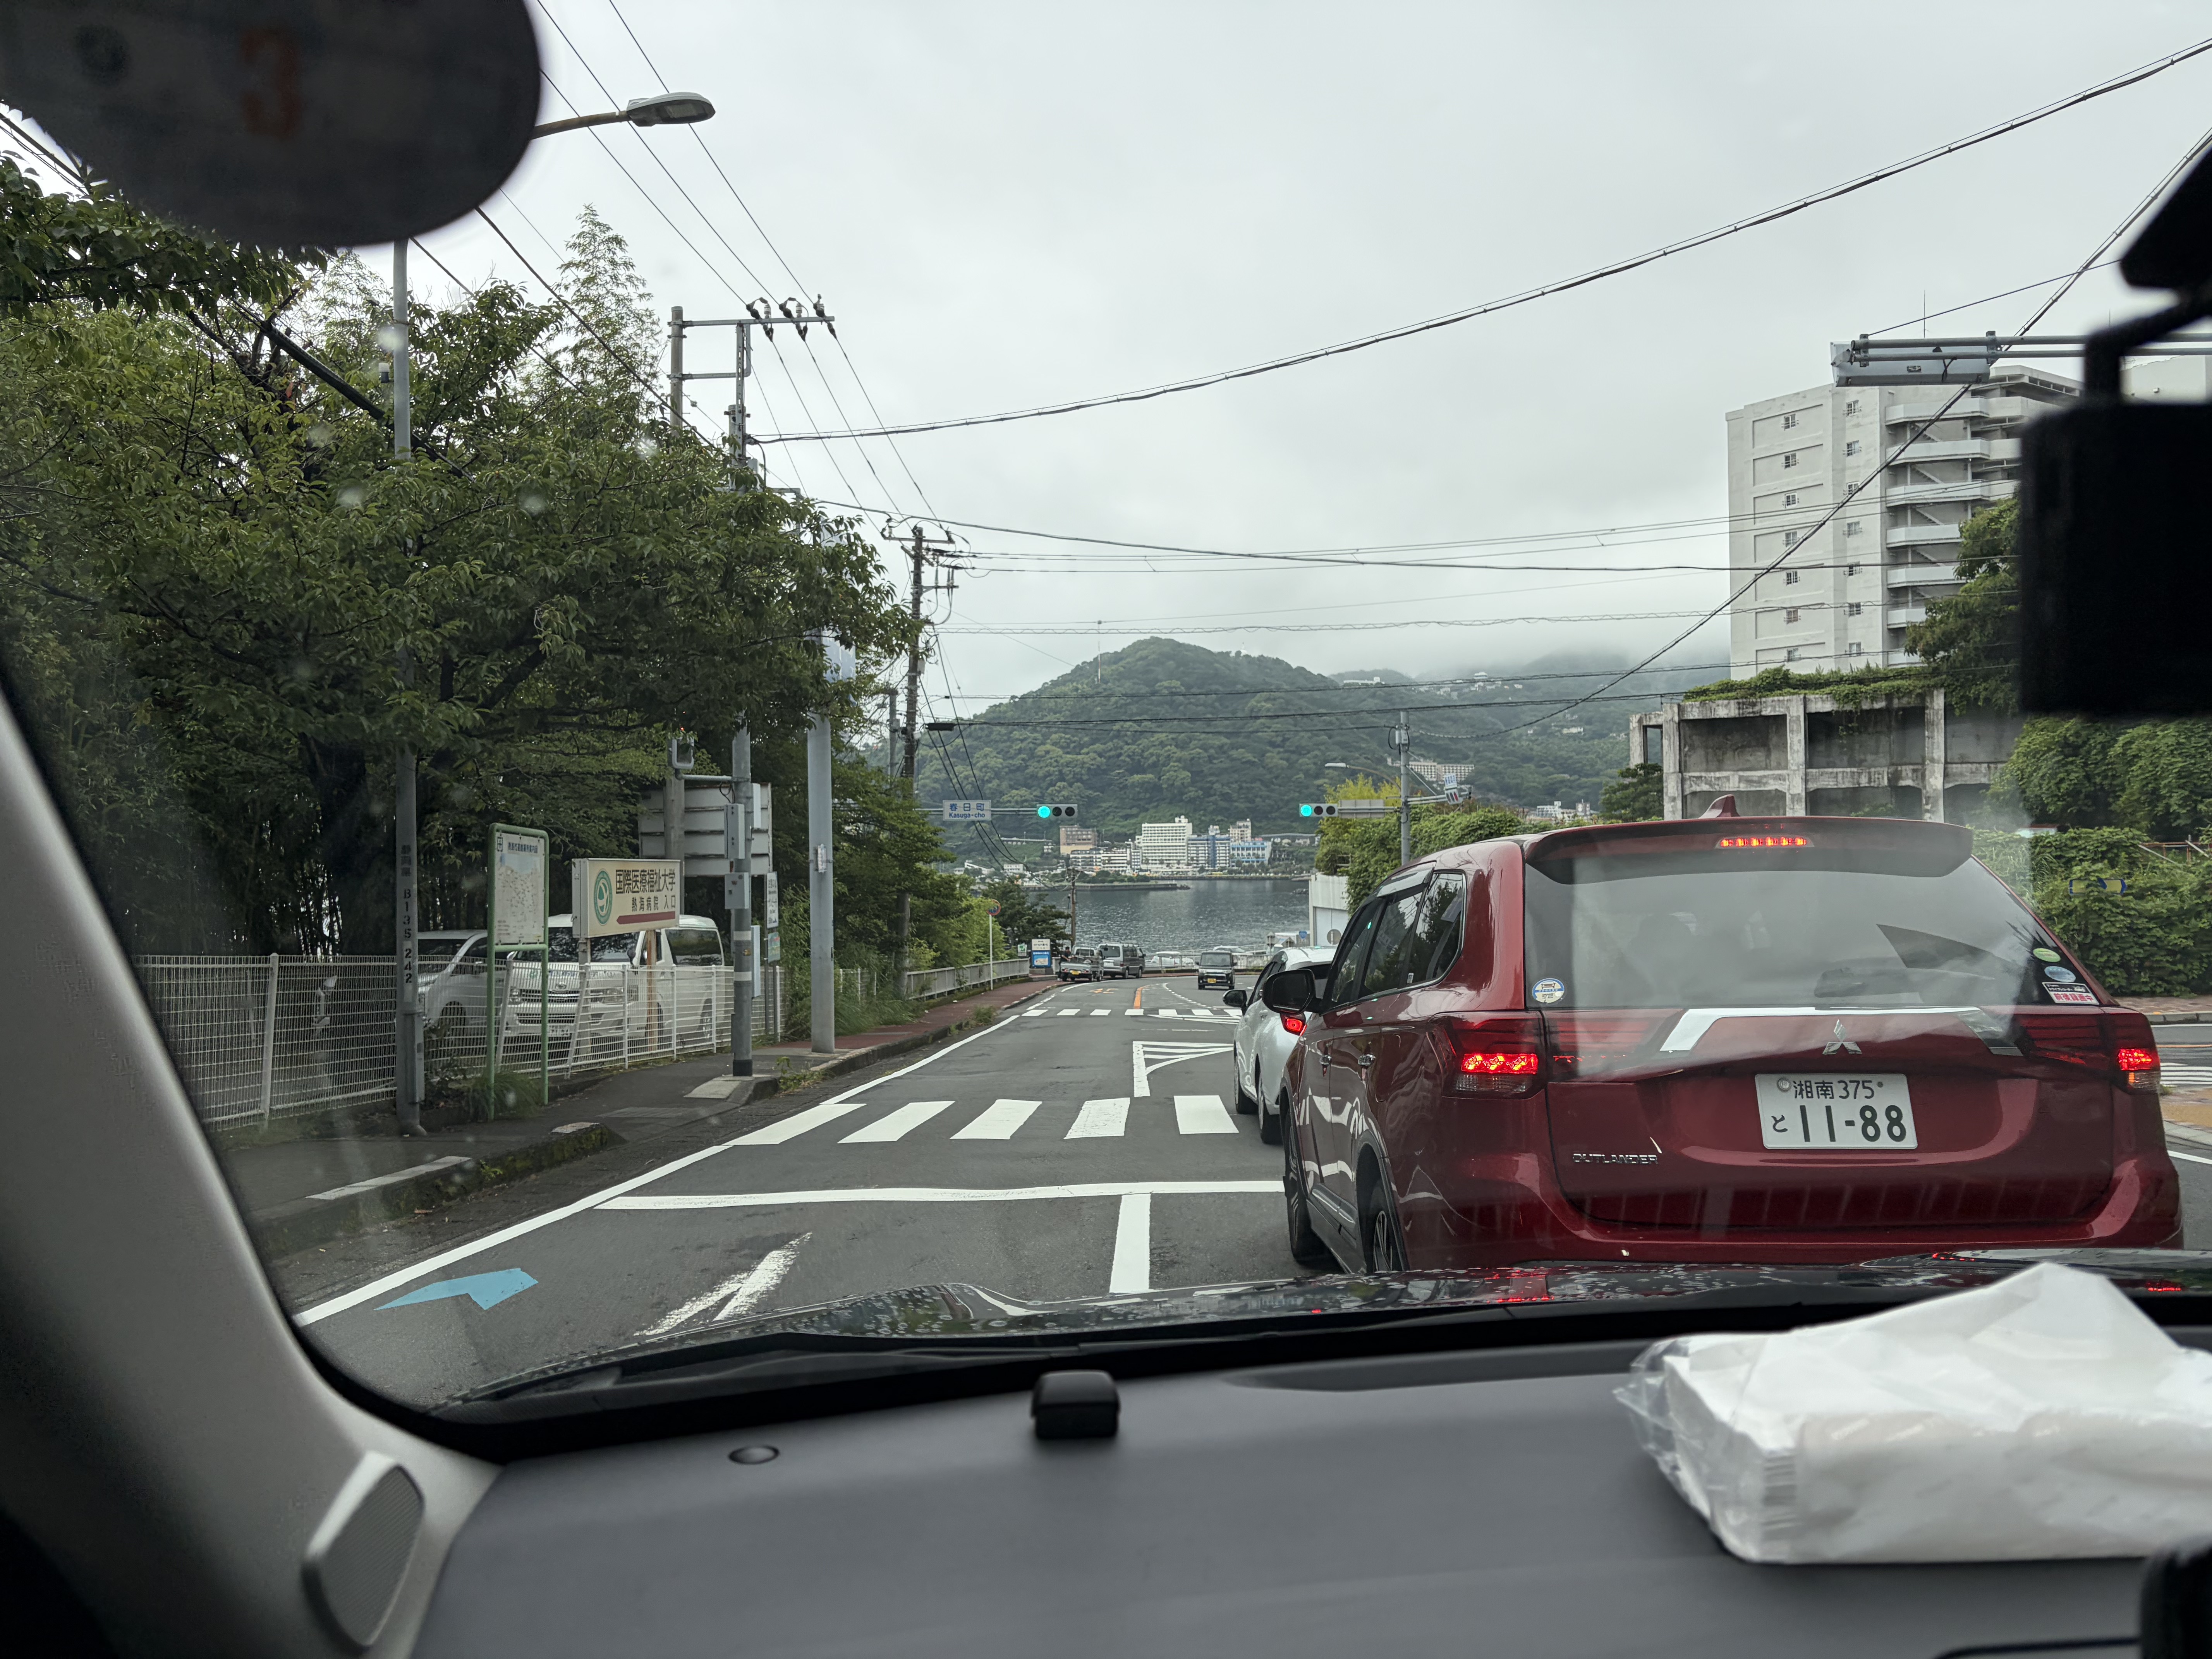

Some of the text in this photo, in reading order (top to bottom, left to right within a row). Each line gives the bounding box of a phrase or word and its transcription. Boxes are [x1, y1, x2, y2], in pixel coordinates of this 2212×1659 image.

[950, 803, 984, 811] 春日町
[616, 869, 676, 894] 国際医療福祉大学
[632, 895, 676, 912] 熱海病院 入口
[1799, 1104, 1906, 1142] 11-88
[1572, 1153, 1659, 1164] OUTLANDER
